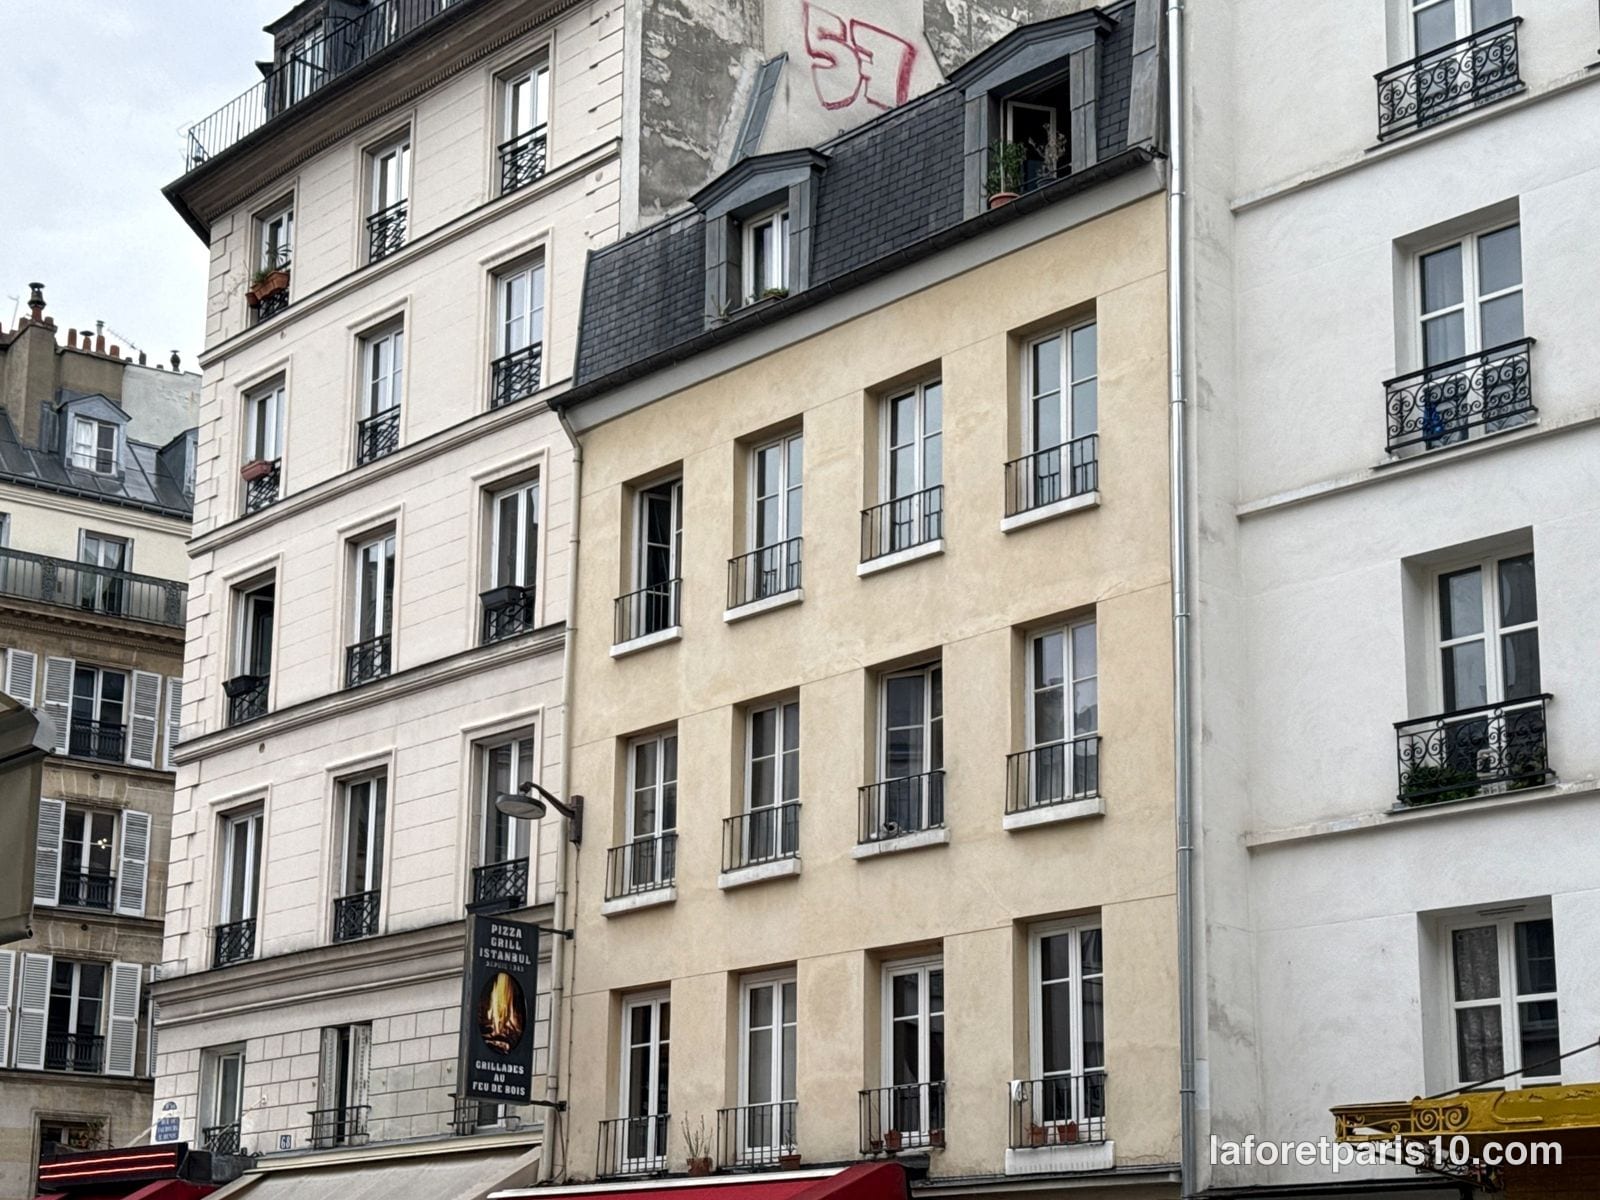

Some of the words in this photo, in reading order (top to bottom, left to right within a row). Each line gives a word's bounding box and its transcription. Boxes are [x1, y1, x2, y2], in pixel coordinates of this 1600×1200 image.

[491, 924, 522, 938] PIZZA
[491, 937, 521, 951] GRILL
[480, 947, 531, 965] ISTANBUL
[475, 1060, 524, 1075] GRILLADES
[494, 1073, 506, 1083] AU
[472, 1081, 490, 1092] FEU
[491, 1083, 503, 1094] DE
[505, 1085, 526, 1096] BOIS
